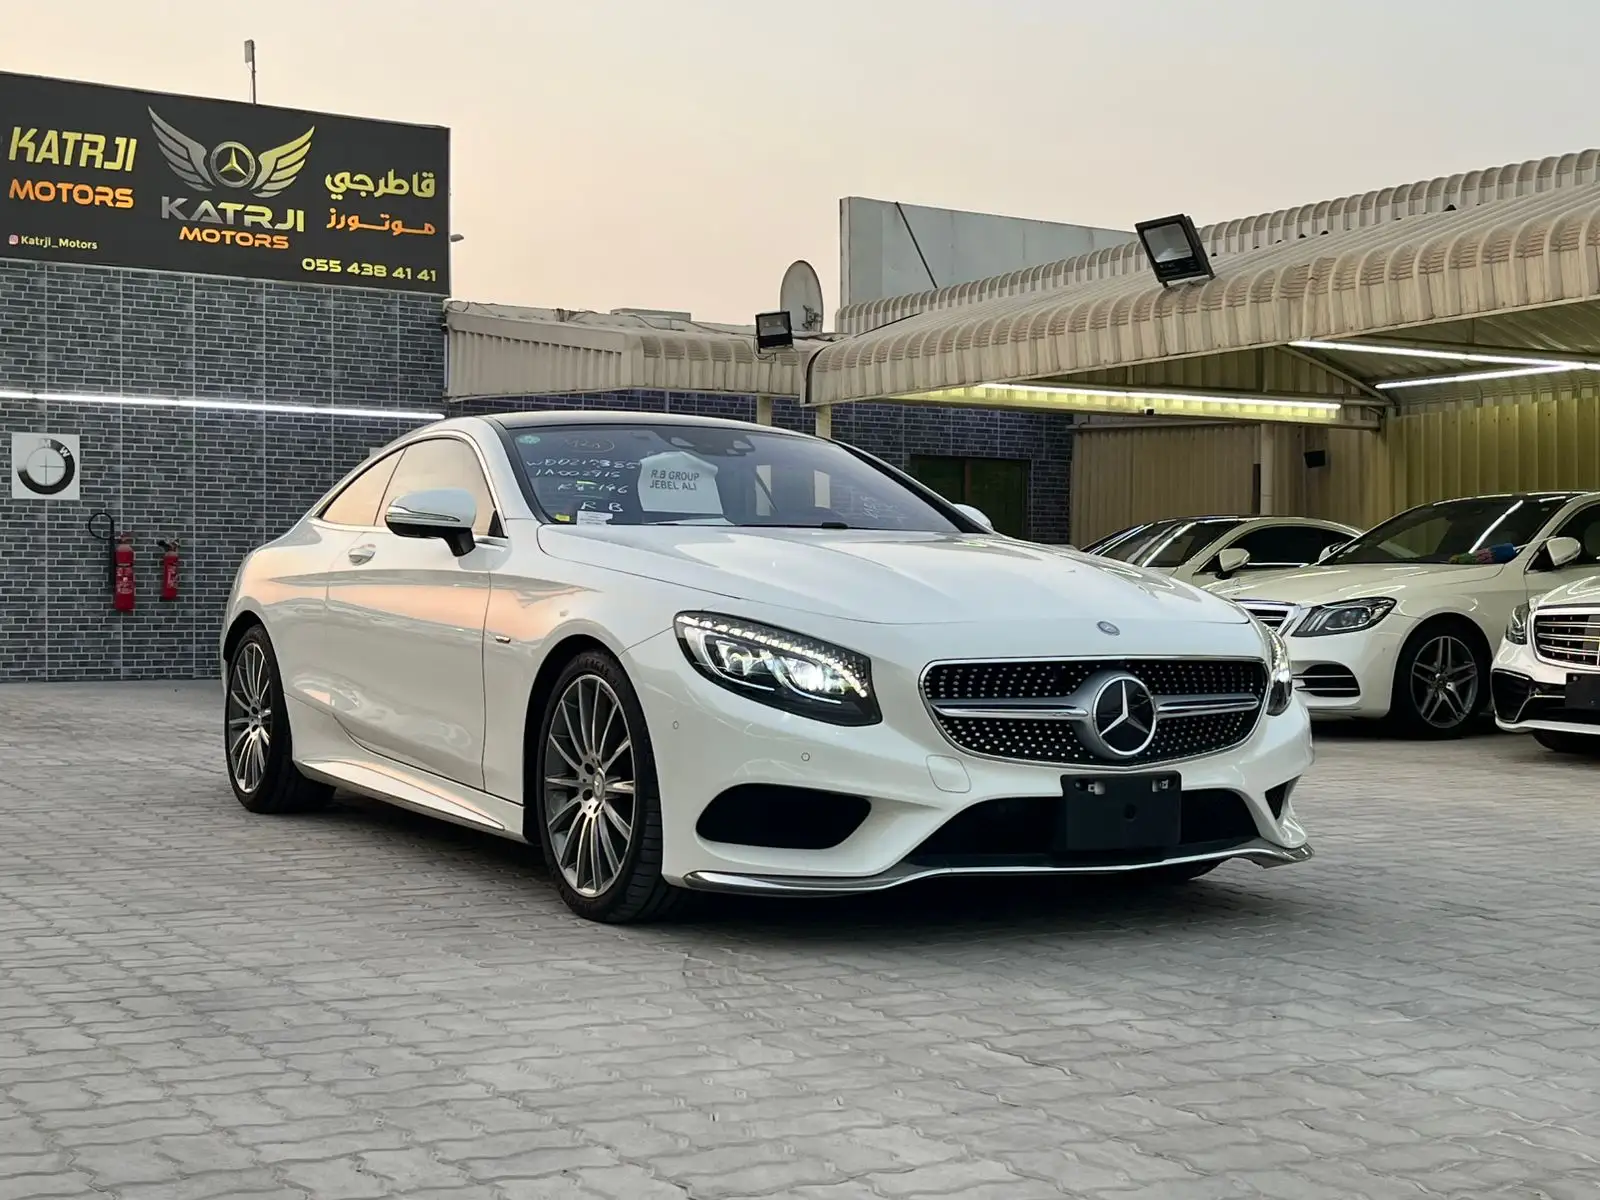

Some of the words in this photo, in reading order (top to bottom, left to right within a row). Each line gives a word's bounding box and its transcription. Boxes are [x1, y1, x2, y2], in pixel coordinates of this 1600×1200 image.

[8, 126, 137, 172] KATRJI
[9, 178, 134, 209] MOTORS
[325, 168, 436, 201] قاطرجي
[161, 195, 305, 232] KATRJI
[178, 226, 290, 249] MOTORS
[302, 257, 342, 273] 055
[346, 262, 387, 278] 438
[392, 266, 412, 280] 41
[416, 268, 437, 282] 41
[649, 479, 680, 490] JEBEL
[681, 481, 698, 491] ALI
[668, 470, 700, 482] GROUP
[608, 502, 624, 512] B
